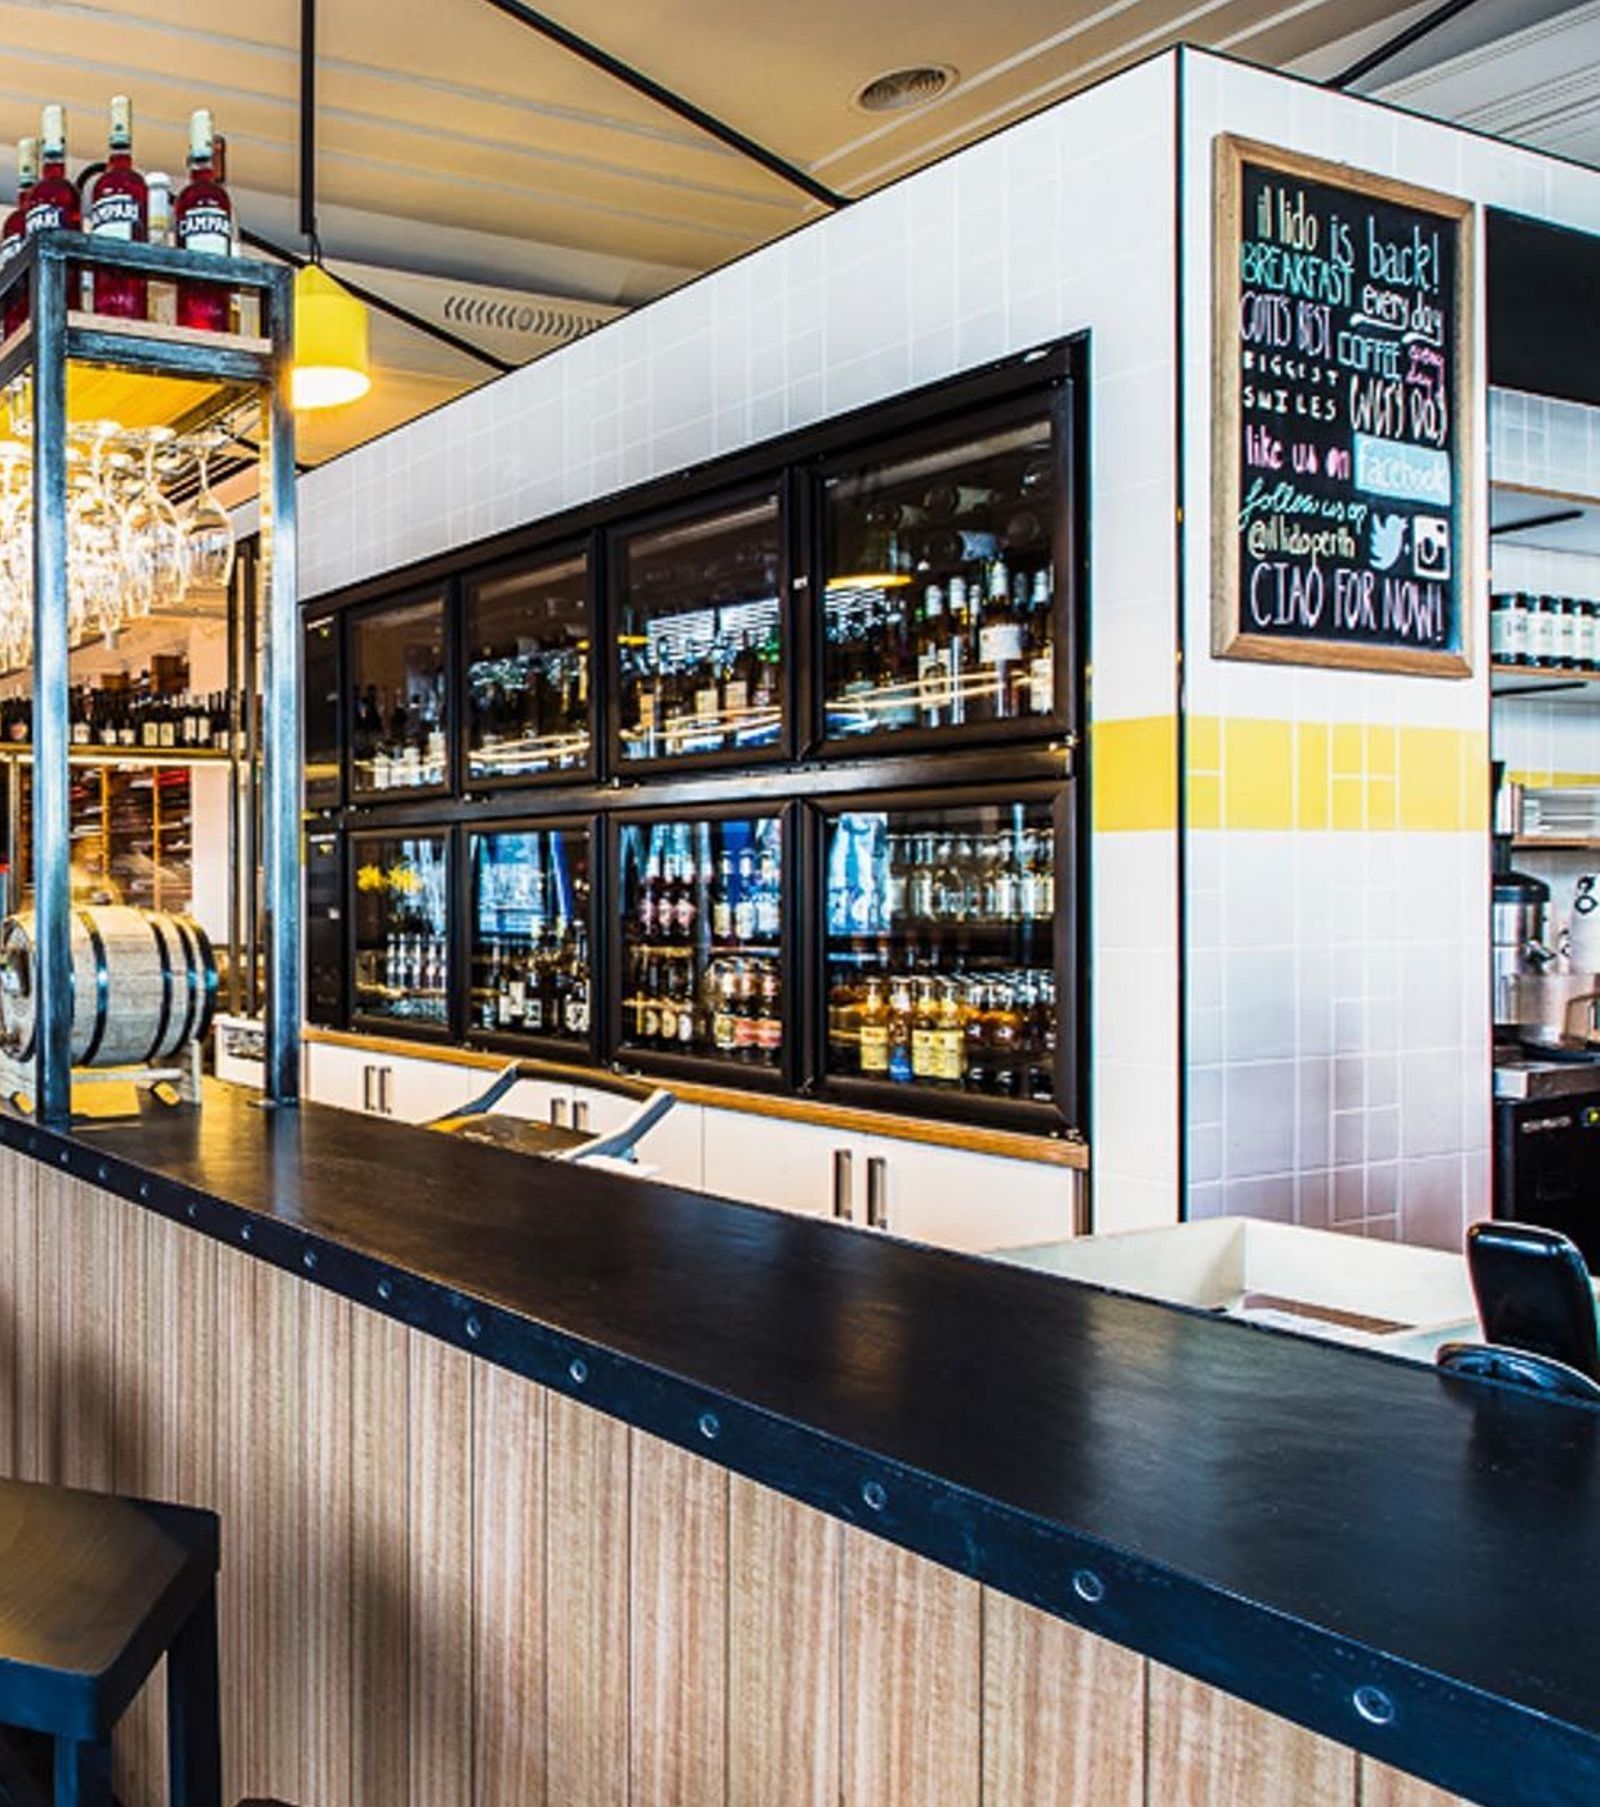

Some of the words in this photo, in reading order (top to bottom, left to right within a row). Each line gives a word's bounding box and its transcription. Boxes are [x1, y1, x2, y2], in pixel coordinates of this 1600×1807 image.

[1279, 188, 1318, 250] lido
[1331, 214, 1354, 266] is
[1369, 215, 1440, 295] back!
[1241, 242, 1354, 307] BREAKFAST
[1361, 284, 1409, 329] every
[1411, 292, 1443, 345] day
[1243, 351, 1339, 386] BIGGEST
[1337, 331, 1400, 379] COFFEE
[1243, 386, 1337, 421] SMILES
[1246, 425, 1283, 469] like
[1292, 443, 1318, 474] us
[1326, 447, 1349, 479] on
[1238, 477, 1319, 531] follow
[1321, 500, 1345, 521] us
[1251, 562, 1324, 627] CIAO
[1334, 568, 1377, 630] FOR
[1383, 578, 1444, 642] NOW!
